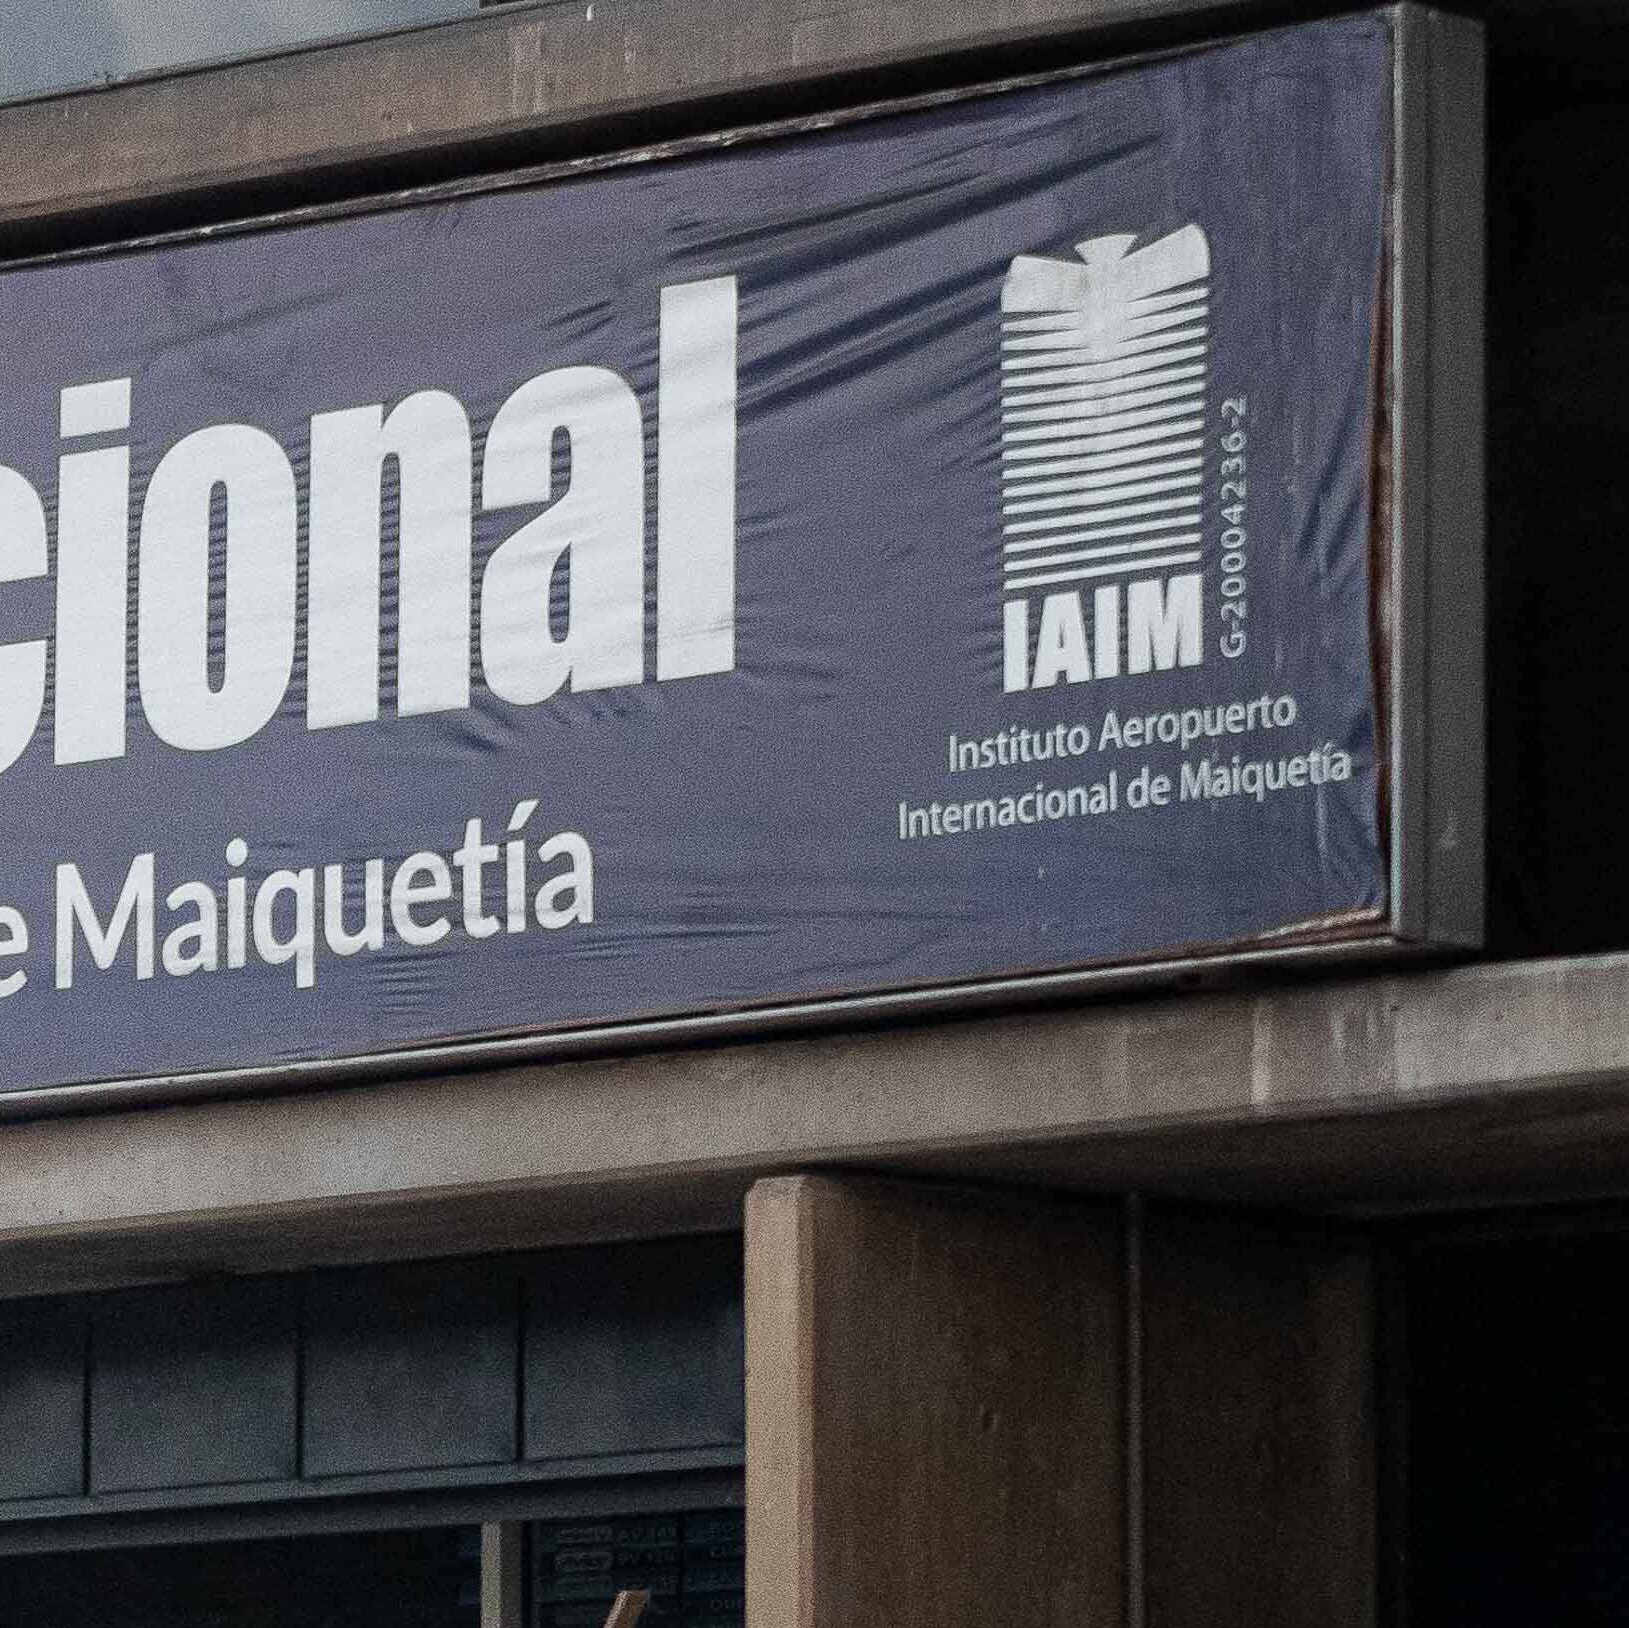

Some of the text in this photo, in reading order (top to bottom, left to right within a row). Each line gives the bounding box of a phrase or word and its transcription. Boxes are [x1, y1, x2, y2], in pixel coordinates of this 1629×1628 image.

[1220, 398, 1247, 658] G-20004236-2
[1003, 573, 1203, 693] IAIM
[898, 741, 1352, 840] Internacional de Maiquetía
[948, 694, 1298, 773] Instituto Aeropuerto
[55, 799, 594, 990] Maiquetía
